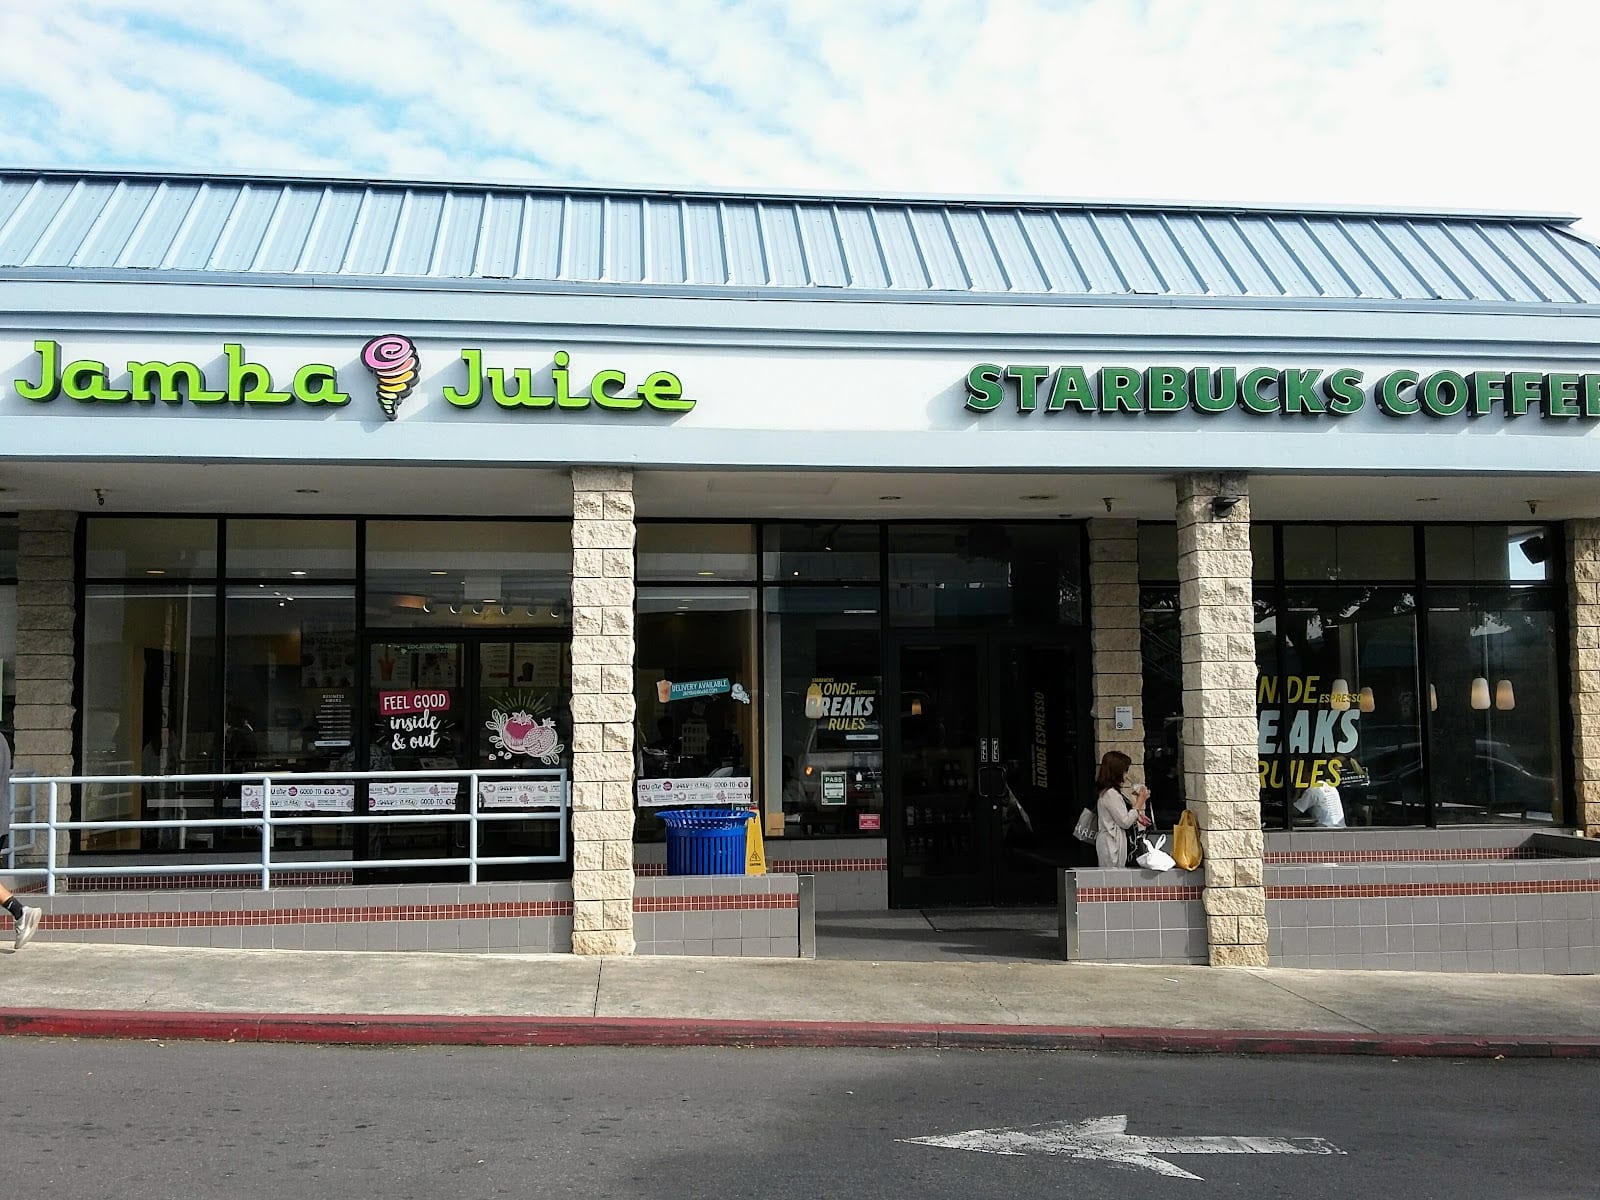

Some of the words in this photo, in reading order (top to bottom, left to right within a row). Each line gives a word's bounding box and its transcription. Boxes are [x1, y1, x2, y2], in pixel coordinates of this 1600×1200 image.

[14, 340, 351, 406] Jamba
[443, 349, 697, 413] Juice
[965, 363, 1365, 417] STARBUCKS
[671, 683, 698, 693] DELIVERY
[698, 679, 728, 690] AVAILABLE
[1257, 675, 1321, 704] NDE
[383, 696, 411, 711] FEEL
[413, 693, 447, 709] GOOD
[813, 697, 875, 717] REAKS
[390, 709, 441, 731] inside
[828, 718, 867, 731] RULES
[1034, 691, 1047, 745] ESPRESSO
[391, 733, 407, 750] &
[410, 731, 441, 749] out
[1258, 709, 1361, 754] EAKS
[1036, 746, 1048, 788] BLONDE
